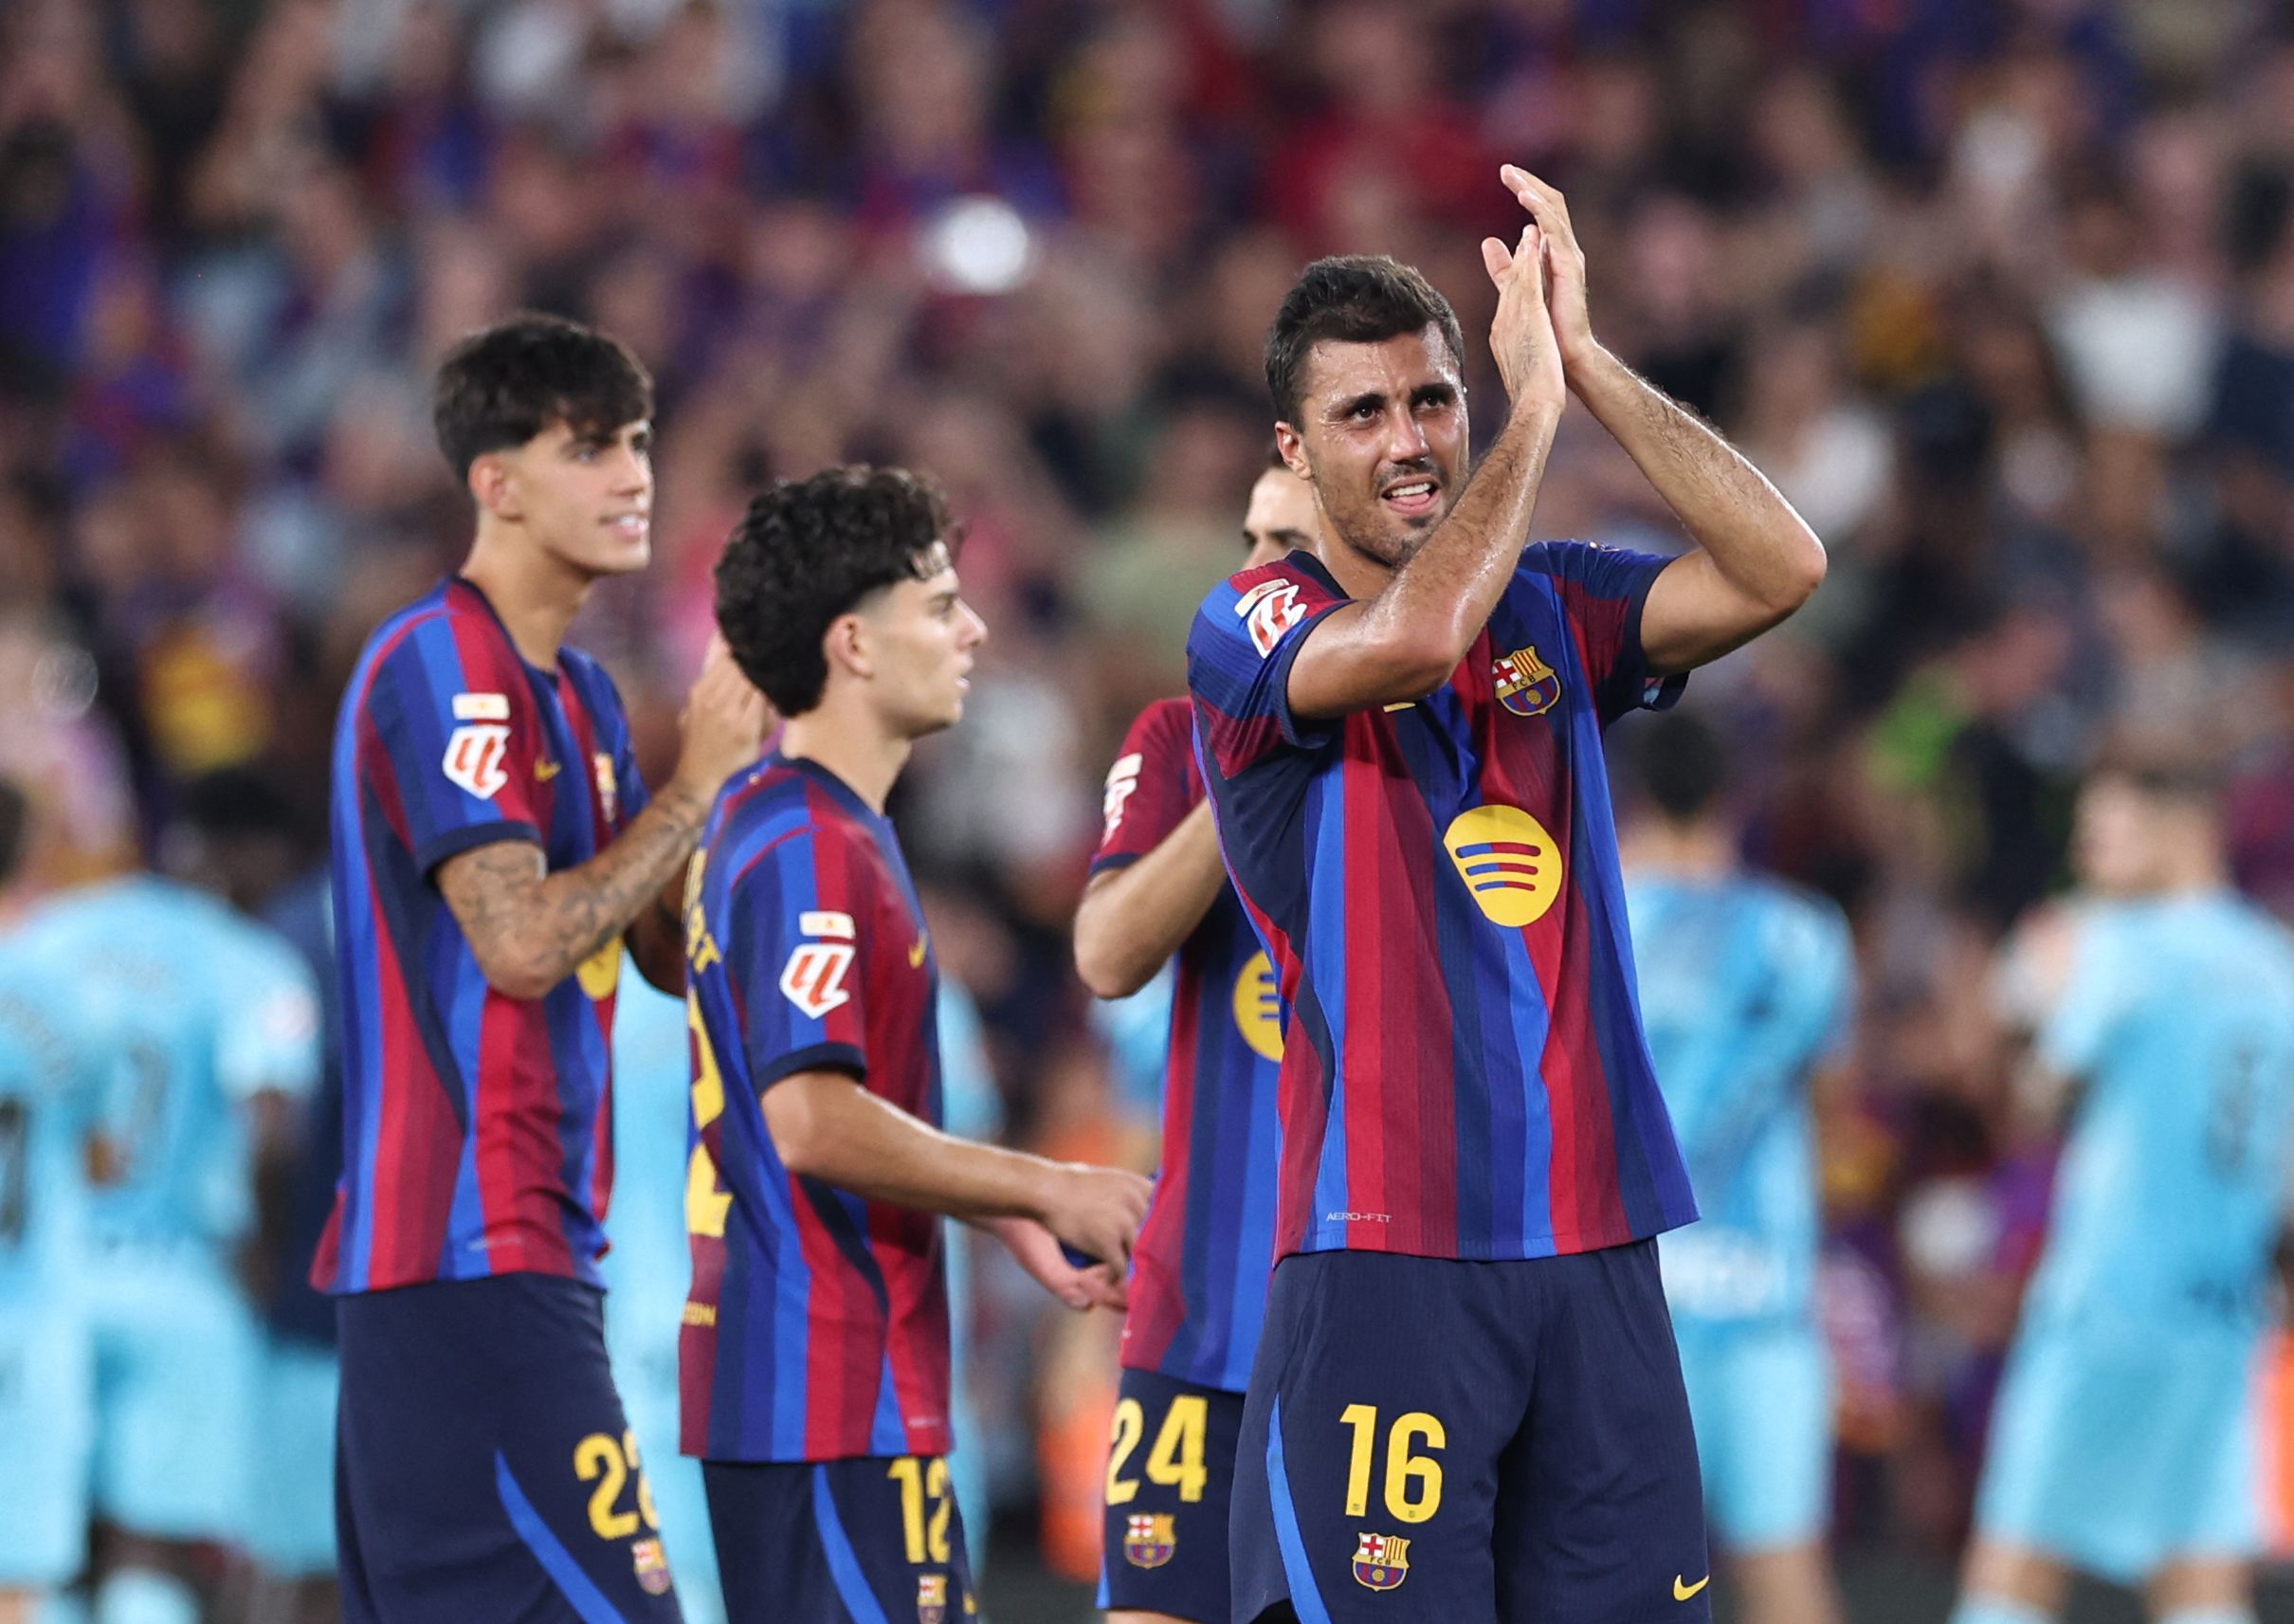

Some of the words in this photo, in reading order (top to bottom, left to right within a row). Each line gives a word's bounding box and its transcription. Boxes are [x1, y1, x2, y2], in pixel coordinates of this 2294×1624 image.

[1512, 674, 1537, 691] FCB
[1325, 1213, 1392, 1223] AERO-FIT
[1105, 1395, 1209, 1505] 24
[1339, 1404, 1446, 1524] 16
[886, 1456, 952, 1564] 12
